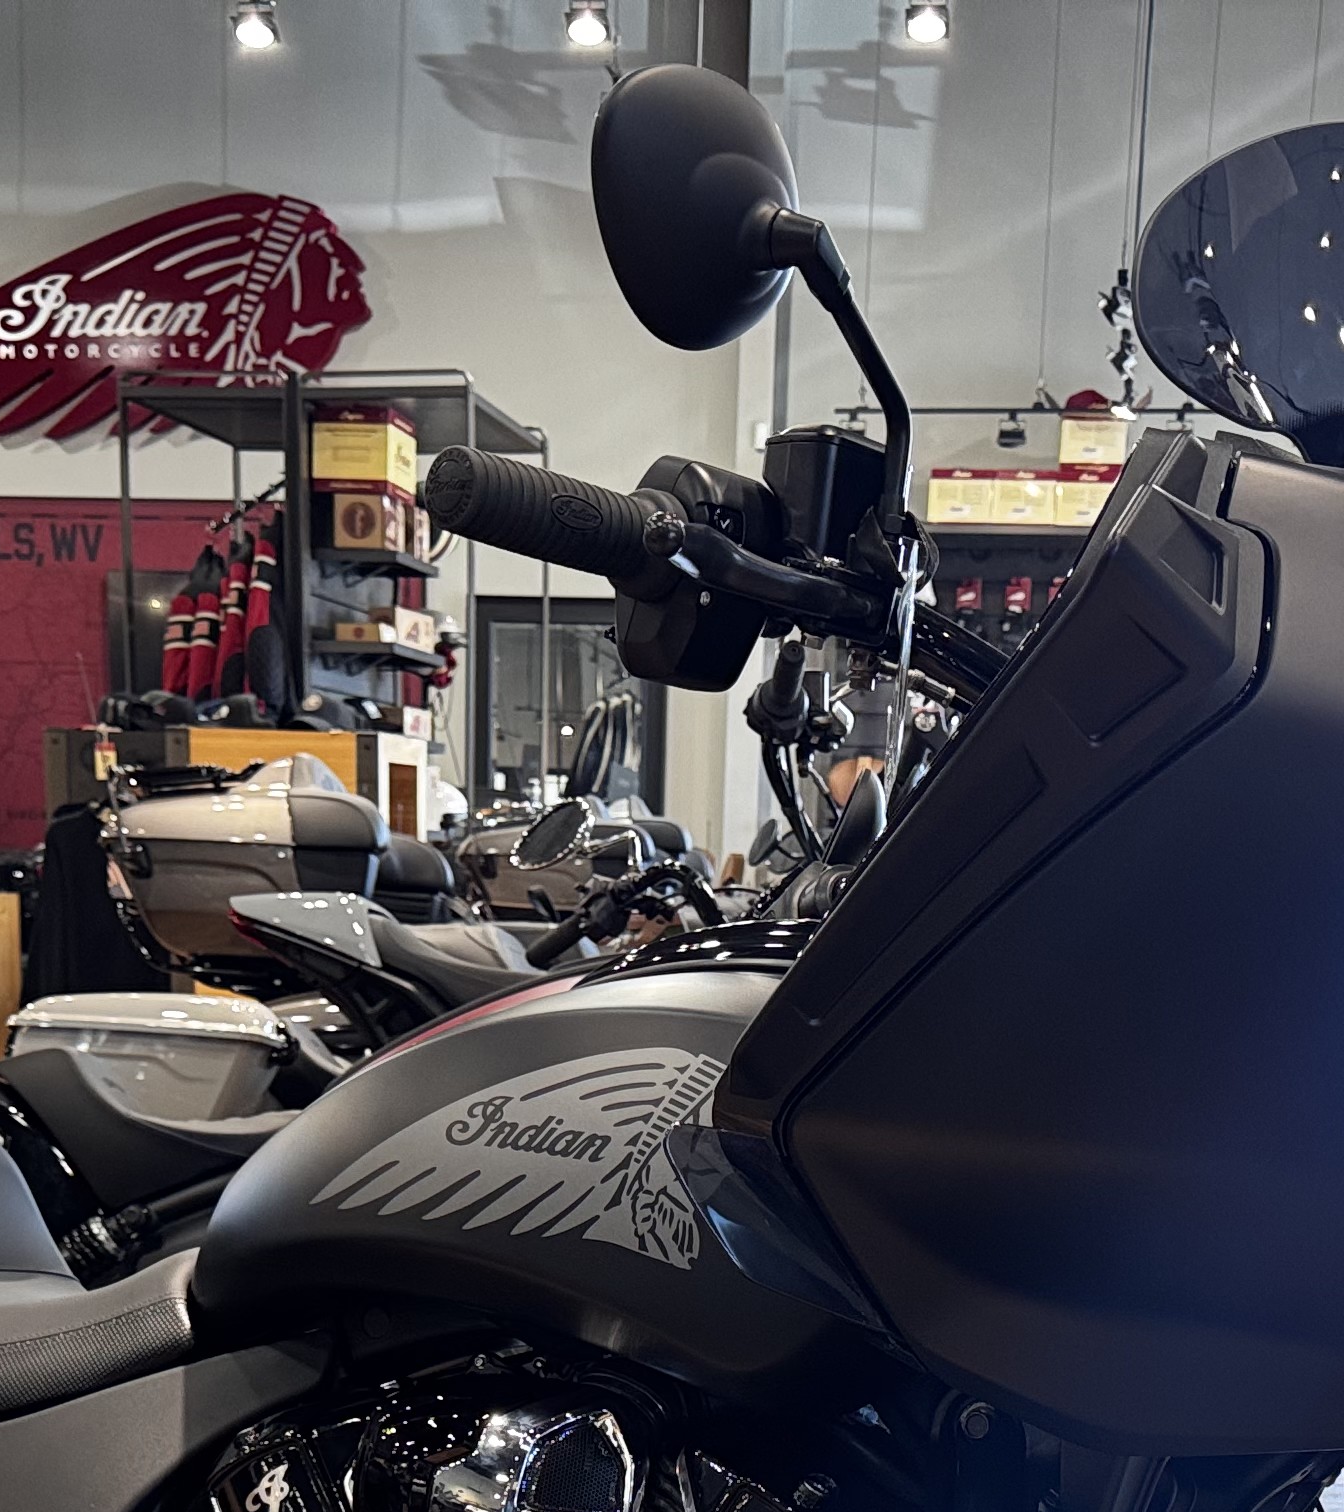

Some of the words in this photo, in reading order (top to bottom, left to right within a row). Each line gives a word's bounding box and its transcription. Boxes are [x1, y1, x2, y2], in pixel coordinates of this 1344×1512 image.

[0, 343, 200, 359] MOTORCYCLE
[51, 524, 104, 562] WV
[445, 1094, 613, 1163] Indian
